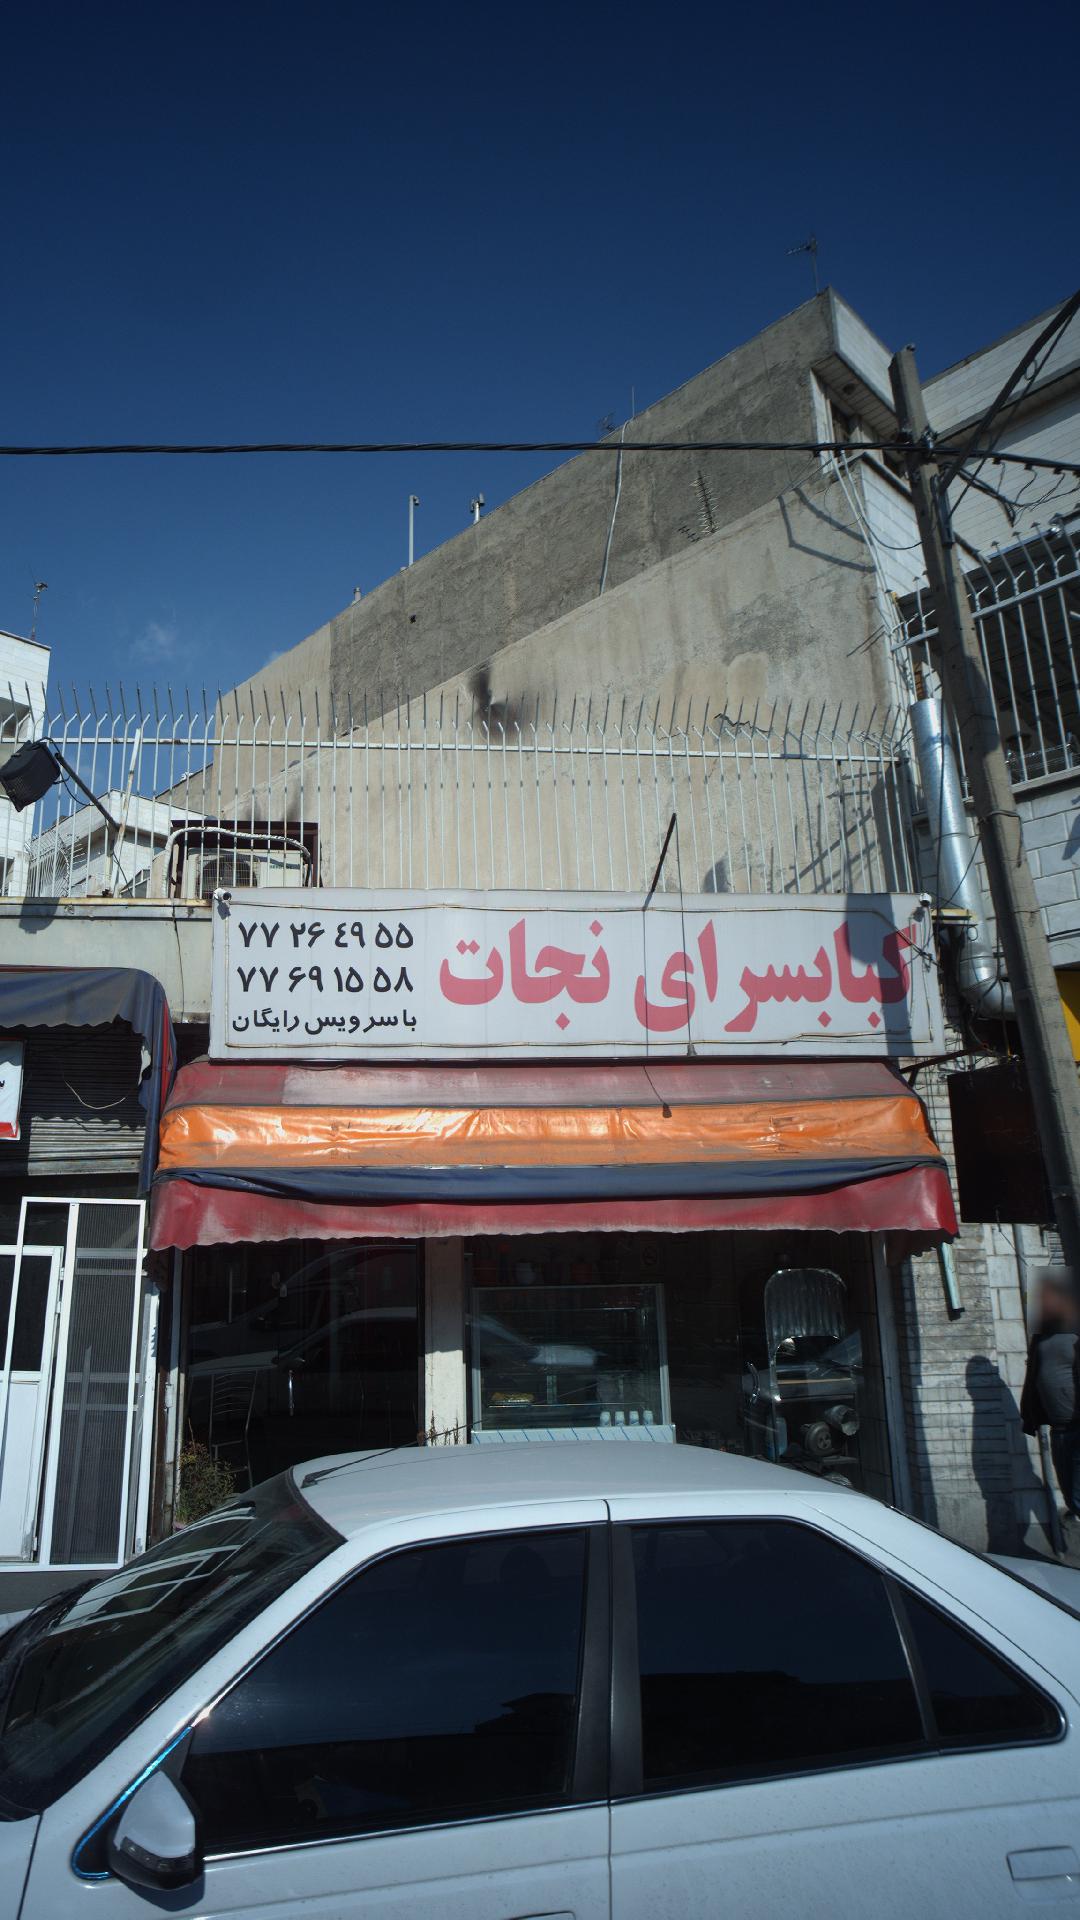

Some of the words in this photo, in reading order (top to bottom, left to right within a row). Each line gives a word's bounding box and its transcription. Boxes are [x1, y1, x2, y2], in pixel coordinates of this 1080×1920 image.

[439, 918, 611, 1031] نجات
[232, 1008, 300, 1032] رایگان
[304, 1016, 399, 1035] سرویس
[402, 1010, 417, 1031] با
